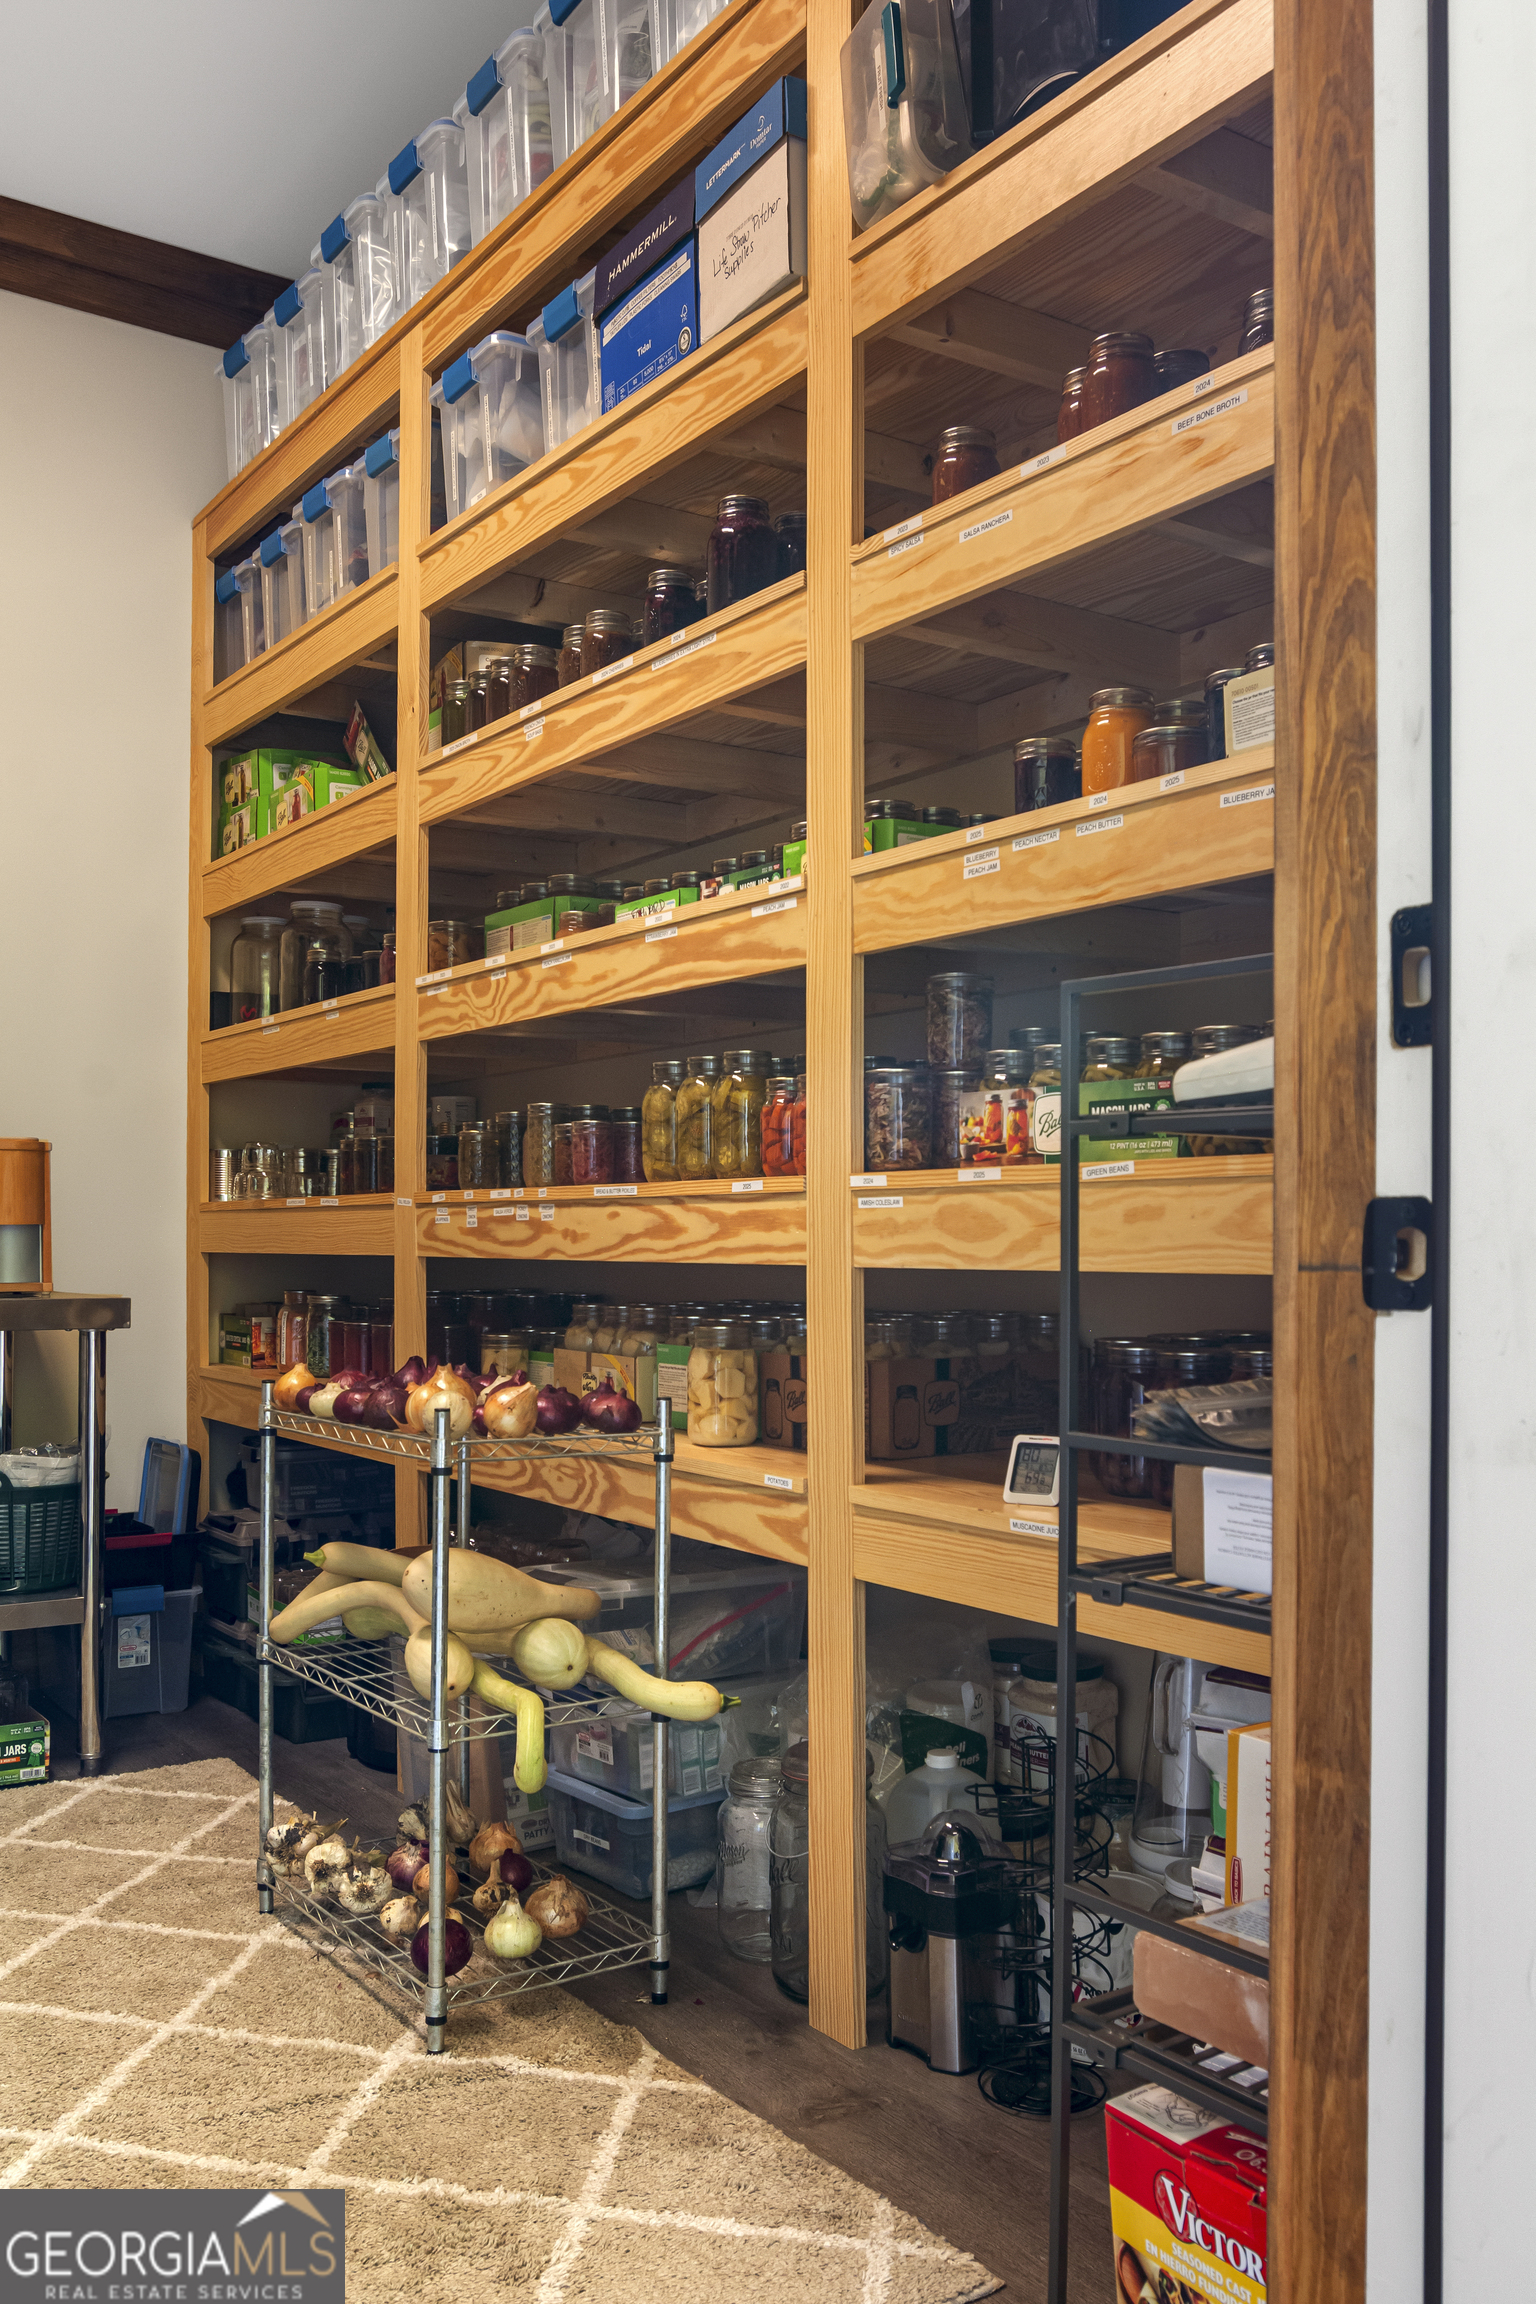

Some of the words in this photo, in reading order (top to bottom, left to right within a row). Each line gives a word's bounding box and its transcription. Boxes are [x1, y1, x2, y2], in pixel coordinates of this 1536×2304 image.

[750, 123, 772, 150] Domtar
[705, 147, 742, 190] LETTERMARK
[713, 247, 729, 277] Life
[752, 197, 781, 232] Pitcher
[607, 216, 674, 283] HAMMERMILL
[724, 241, 754, 279] Supplies
[636, 339, 652, 357] Tidal
[1195, 379, 1211, 394] 2024
[1177, 417, 1195, 431] BEEF
[1196, 407, 1216, 422] BONE
[1216, 395, 1241, 415] BROTH
[1036, 455, 1050, 468] 2023
[963, 527, 981, 540] SALSA
[981, 513, 1010, 534] RANCHERA
[905, 536, 921, 549] SALSA
[1164, 776, 1180, 787] 2025
[1093, 795, 1108, 806] 2024
[1223, 789, 1266, 805] BLUEBERRY
[1266, 787, 1275, 796] JA
[1076, 824, 1097, 834] PEACH
[1097, 817, 1122, 829] BUTTER
[969, 830, 983, 840] 2025
[1014, 838, 1034, 848] PEACH
[1034, 831, 1058, 843] NECTAR
[965, 850, 997, 864] BLUEBERRY
[967, 866, 986, 876] PEACH
[986, 862, 998, 872] JAM
[763, 903, 777, 913] PEACH
[777, 901, 785, 909] JAM
[646, 931, 669, 941] STRAWBERRY
[1091, 1104, 1125, 1116] MASON
[1038, 1110, 1062, 1136] Bal
[973, 1171, 985, 1179] 2025
[1086, 1167, 1108, 1177] GREEN
[1108, 1164, 1130, 1174] BEANS
[787, 1390, 807, 1411] Ball
[928, 1390, 956, 1415] Ball
[767, 1476, 789, 1487] POTATOES
[1012, 1521, 1045, 1533] MUSCADINE
[1046, 1526, 1060, 1535] JUIC
[3, 1743, 27, 1757] JARS
[524, 1826, 549, 1840] PATTY
[1160, 2175, 1267, 2287] VICTOR
[1145, 2239, 1158, 2258] EN
[1160, 2247, 1197, 2284] HIERRO
[1198, 2276, 1243, 2304] FUNDID
[1171, 2242, 1224, 2286] SEASONED
[1225, 2277, 1252, 2304] CAST
